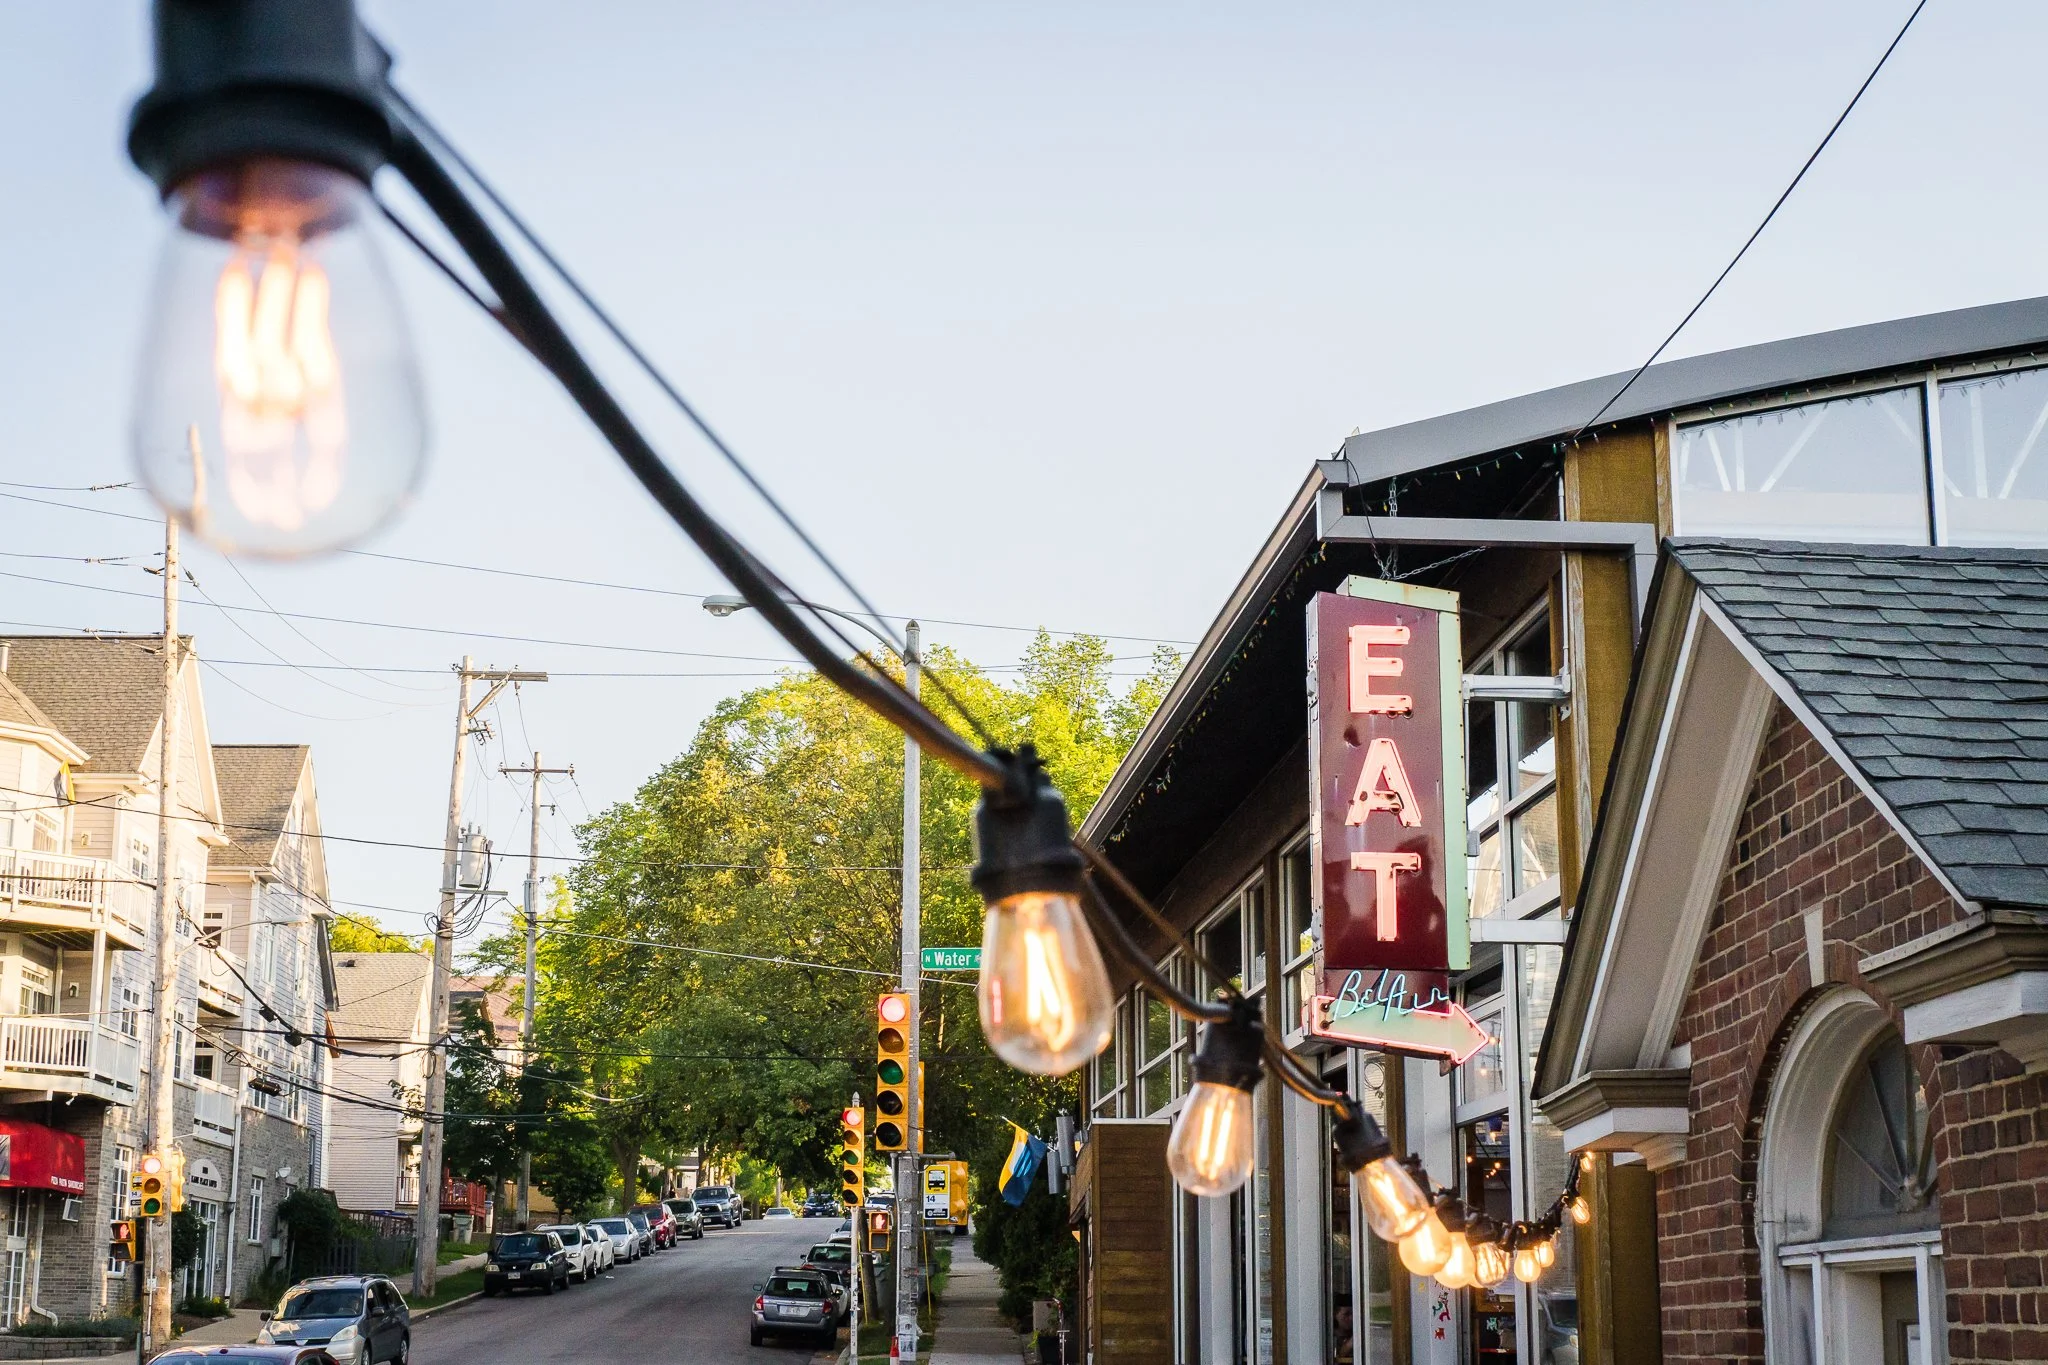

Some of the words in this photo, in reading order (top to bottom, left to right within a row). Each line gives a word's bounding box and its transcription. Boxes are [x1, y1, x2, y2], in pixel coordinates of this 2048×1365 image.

[1345, 625, 1421, 941] EAT
[925, 955, 931, 963] N
[934, 951, 972, 966] Water
[926, 1195, 936, 1203] 14
